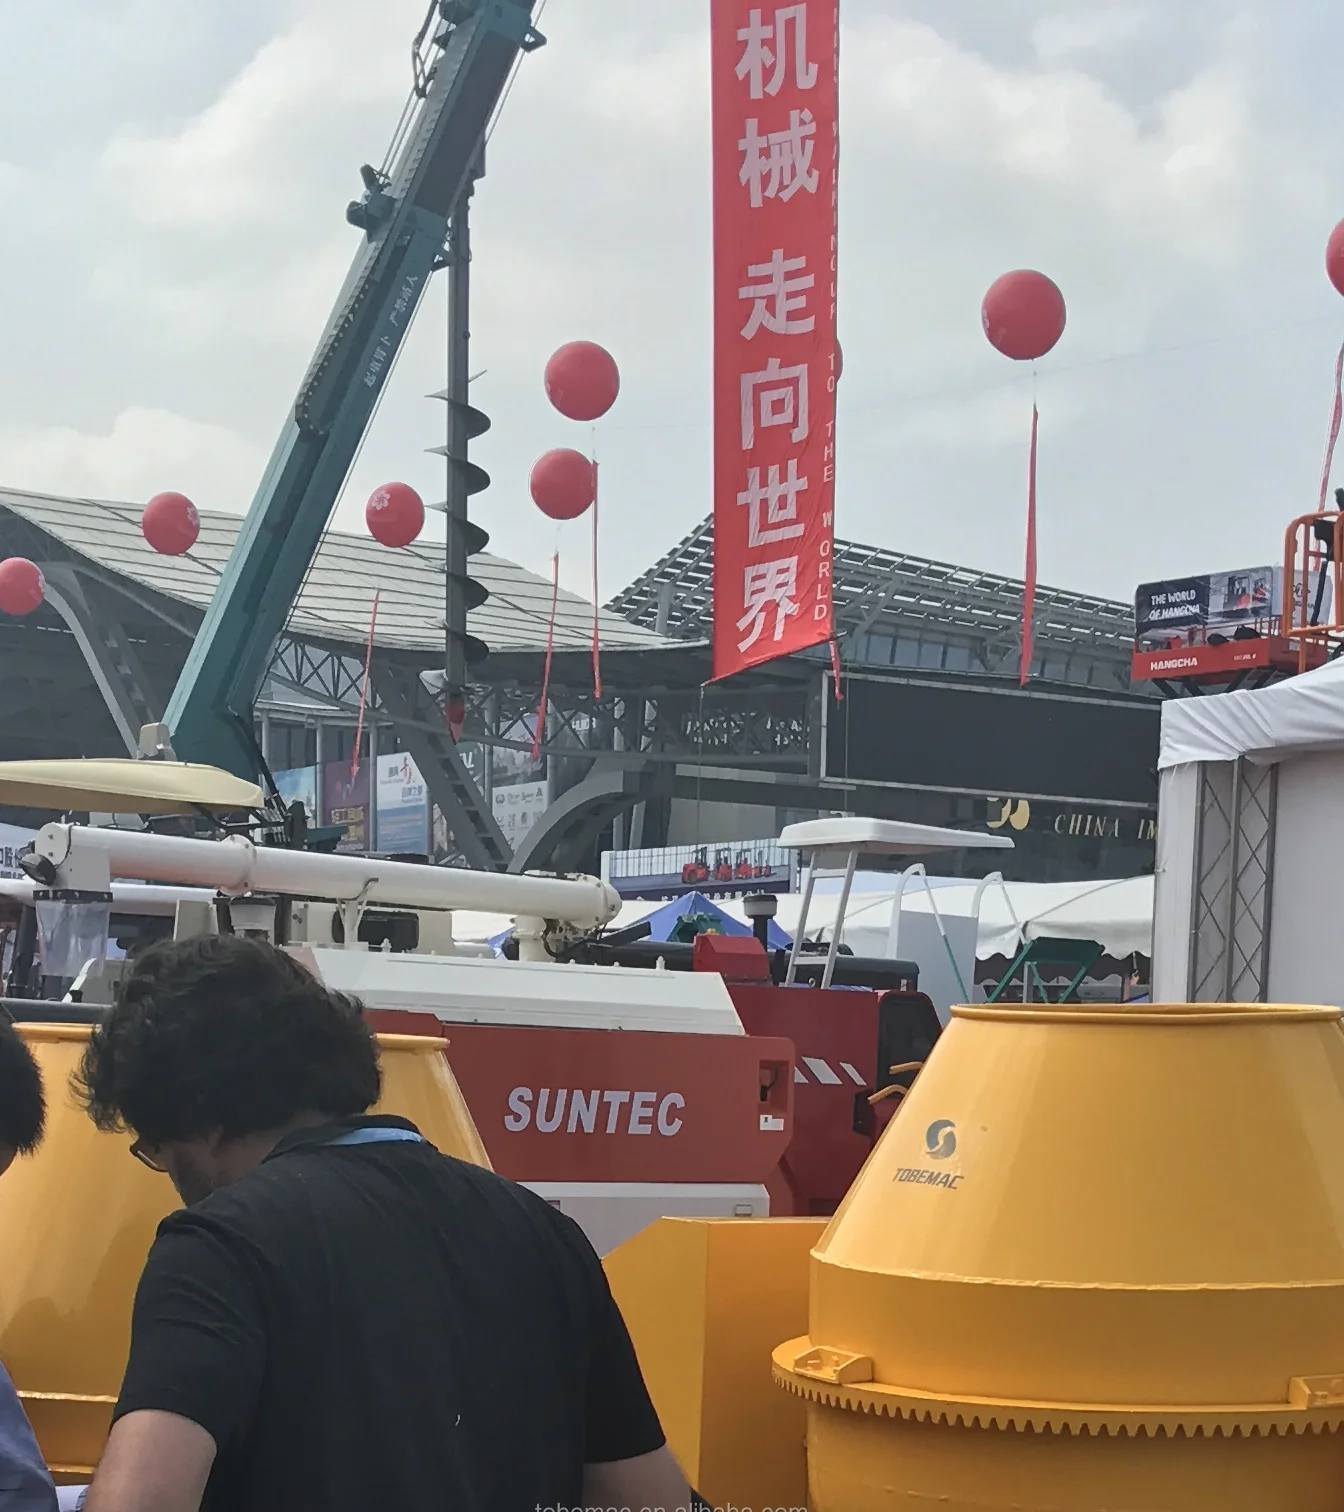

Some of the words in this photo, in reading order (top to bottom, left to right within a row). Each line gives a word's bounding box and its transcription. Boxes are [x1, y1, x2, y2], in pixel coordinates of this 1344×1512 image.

[735, 4, 819, 652] 机械走向世界
[826, 352, 836, 393] TO
[822, 421, 835, 483] THE
[813, 511, 833, 622] WORLD
[1150, 594, 1166, 606] THE
[1168, 589, 1196, 603] WORLD
[1162, 603, 1200, 620] HANGCHA
[1150, 656, 1198, 671] HANGCHA
[1054, 813, 1119, 838] CHINA
[504, 1086, 685, 1136] SUNTEC
[892, 1167, 965, 1190] TOBEMAC
